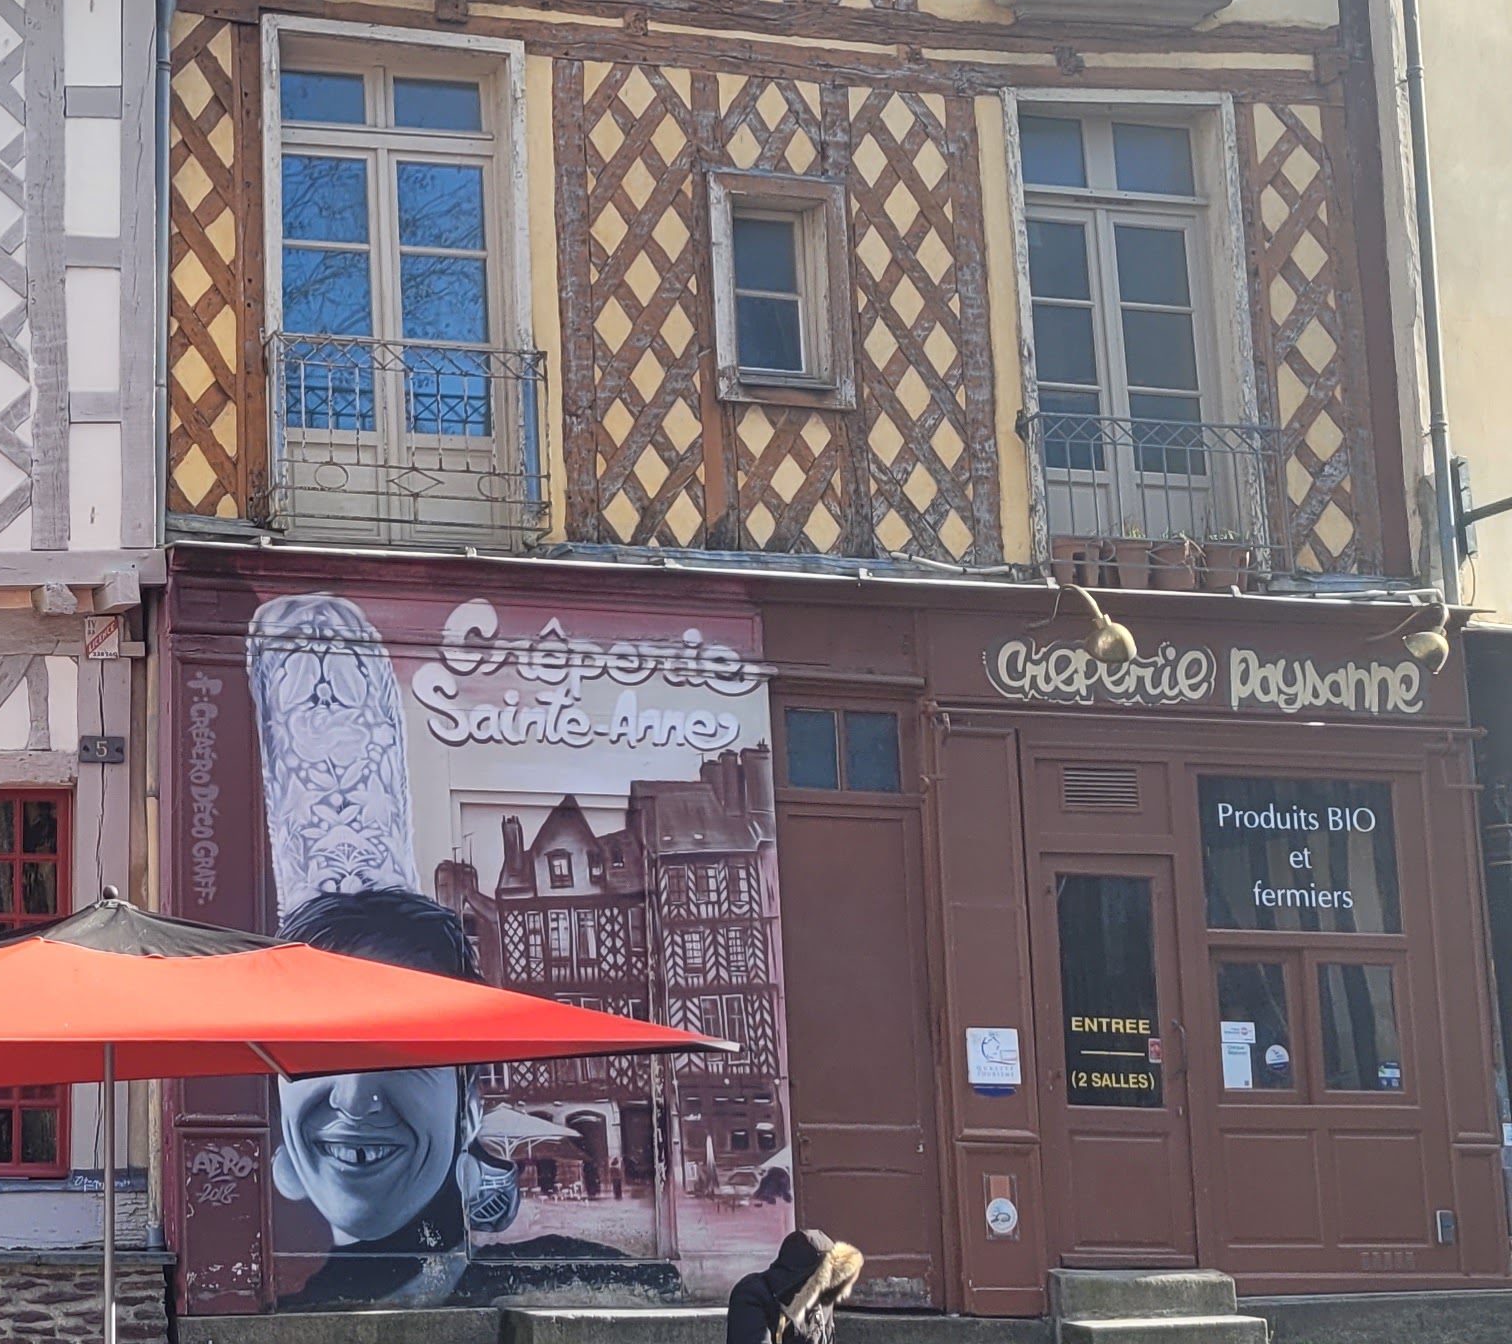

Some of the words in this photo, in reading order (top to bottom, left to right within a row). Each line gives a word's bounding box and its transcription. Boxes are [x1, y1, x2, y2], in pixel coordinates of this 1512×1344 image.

[439, 598, 778, 701] Crêperie
[1230, 647, 1423, 714] Paysanne
[96, 740, 108, 758] 5
[1217, 803, 1320, 830] Produits
[1327, 807, 1376, 833] BIO
[1289, 847, 1312, 869] et
[1253, 880, 1354, 909] fermiers
[1071, 1016, 1151, 1034] ENTREE
[1071, 1070, 1087, 1089] (2
[1091, 1071, 1155, 1090] SALLES)
[198, 1182, 237, 1204] 2018
